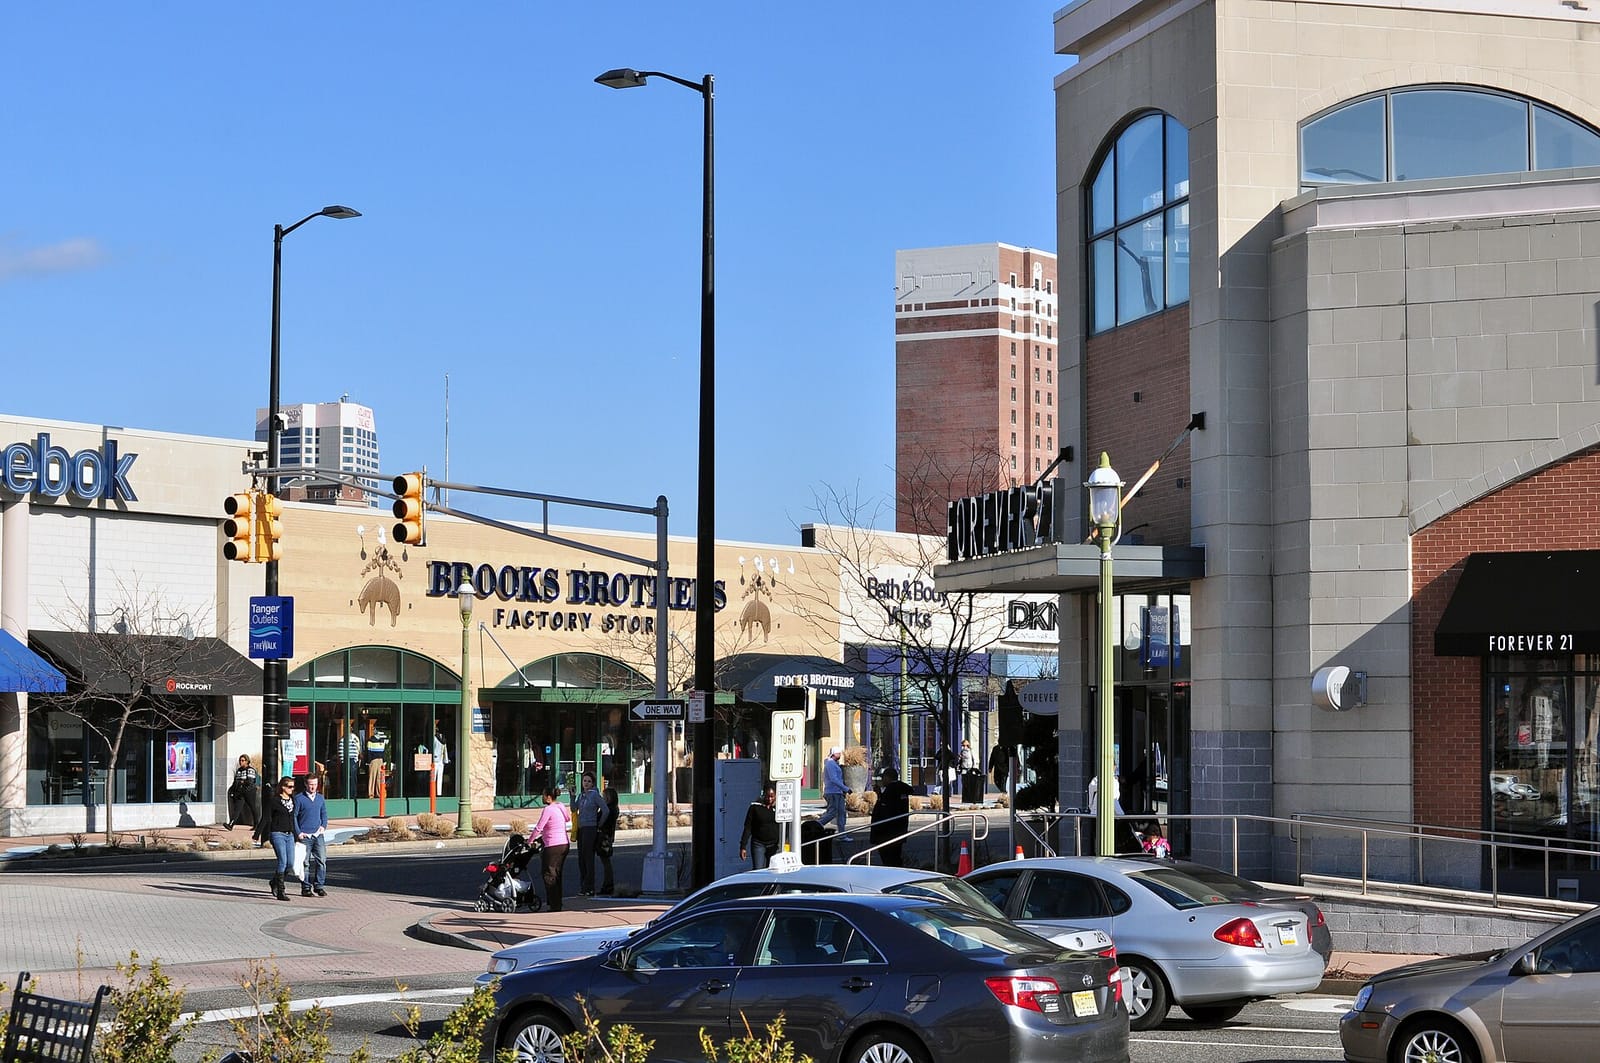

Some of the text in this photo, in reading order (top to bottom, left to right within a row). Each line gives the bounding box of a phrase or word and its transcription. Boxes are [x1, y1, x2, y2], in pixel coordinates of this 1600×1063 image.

[0, 432, 139, 501] ebok
[947, 479, 1057, 561] FOREVER 21
[426, 560, 560, 603] BROOKS
[867, 577, 900, 599] Bath
[901, 579, 912, 600] &
[251, 604, 280, 615] Tanger
[252, 614, 279, 624] Outlets
[493, 608, 657, 635] FACTORY STOR
[1489, 634, 1573, 651] FOREVER 21
[176, 682, 212, 690] ROCKPORT
[810, 674, 855, 688] BROTHERS
[820, 688, 838, 696] STORE
[1023, 692, 1059, 703] FOREVER
[645, 705, 679, 714] ONE WAY
[782, 718, 794, 731] NO
[780, 735, 796, 745] TURN
[783, 750, 793, 759] ON
[781, 763, 794, 774] RED
